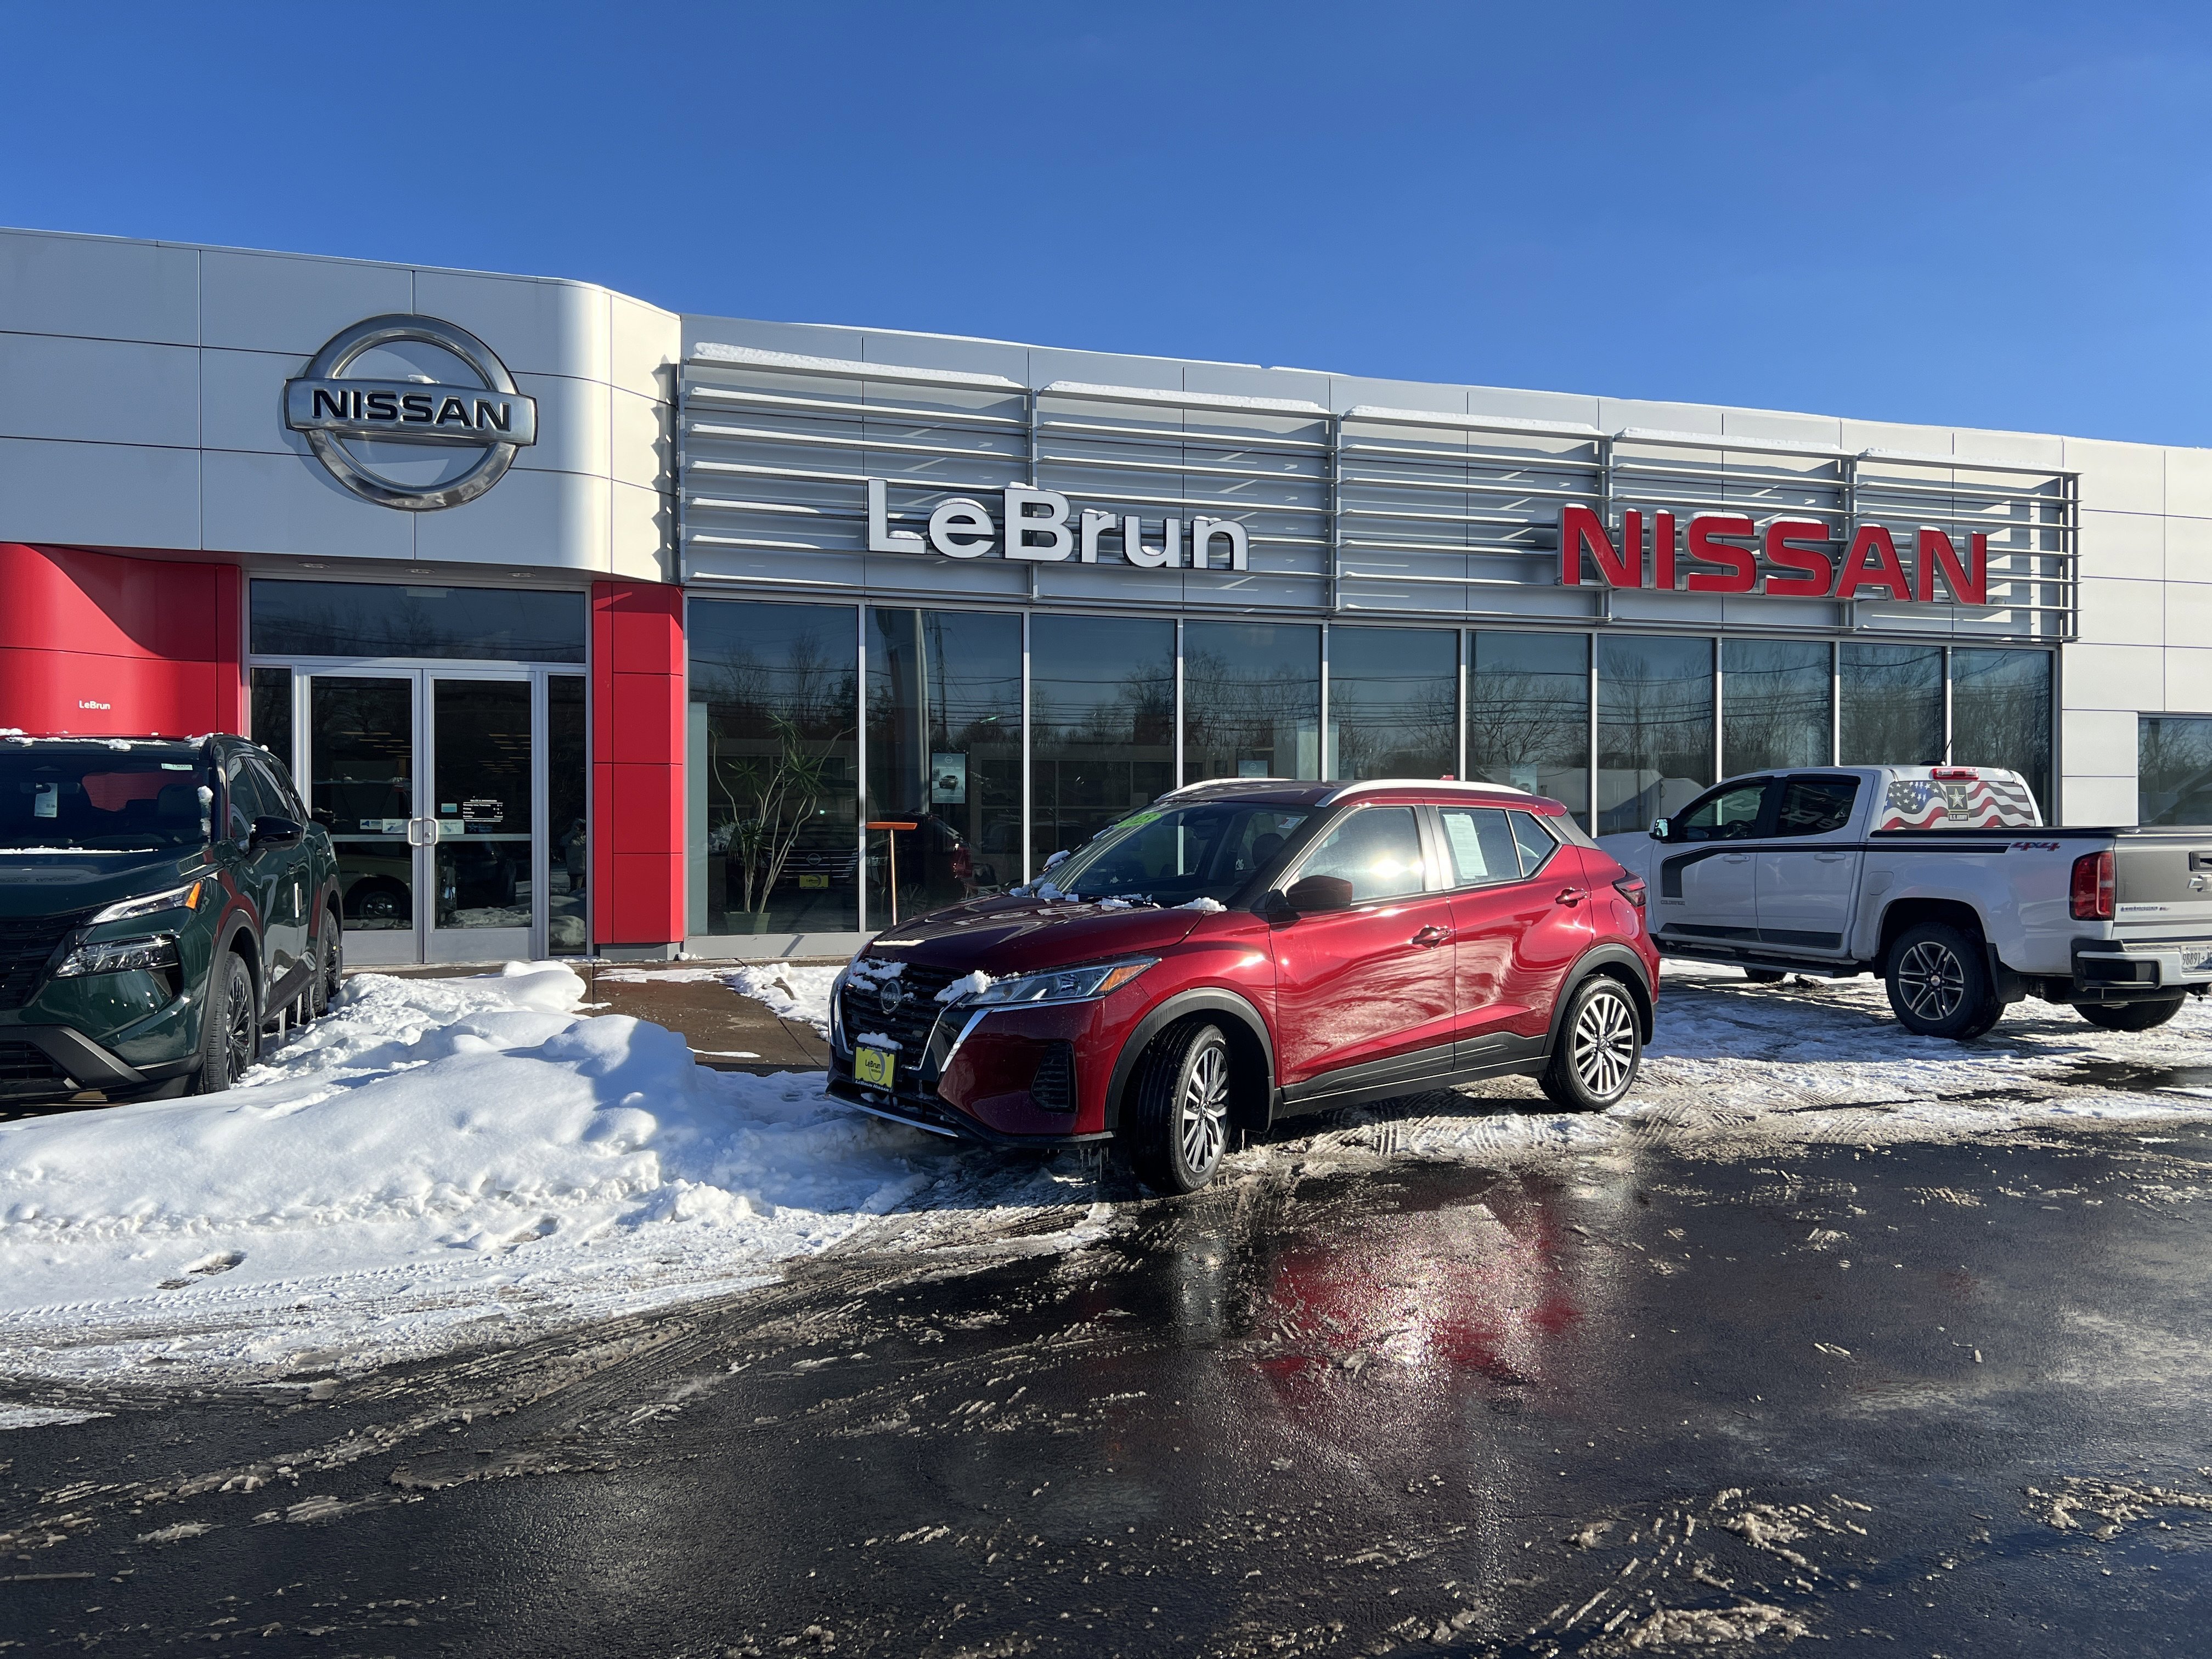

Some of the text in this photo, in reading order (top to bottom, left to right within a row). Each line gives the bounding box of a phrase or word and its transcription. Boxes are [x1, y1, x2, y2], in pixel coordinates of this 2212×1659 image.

[313, 388, 511, 431] NISSAN
[867, 478, 1250, 571] LeBrun
[1557, 504, 1988, 605] NISSAN
[79, 700, 111, 710] LeBrun
[865, 1059, 881, 1069] LeBrun
